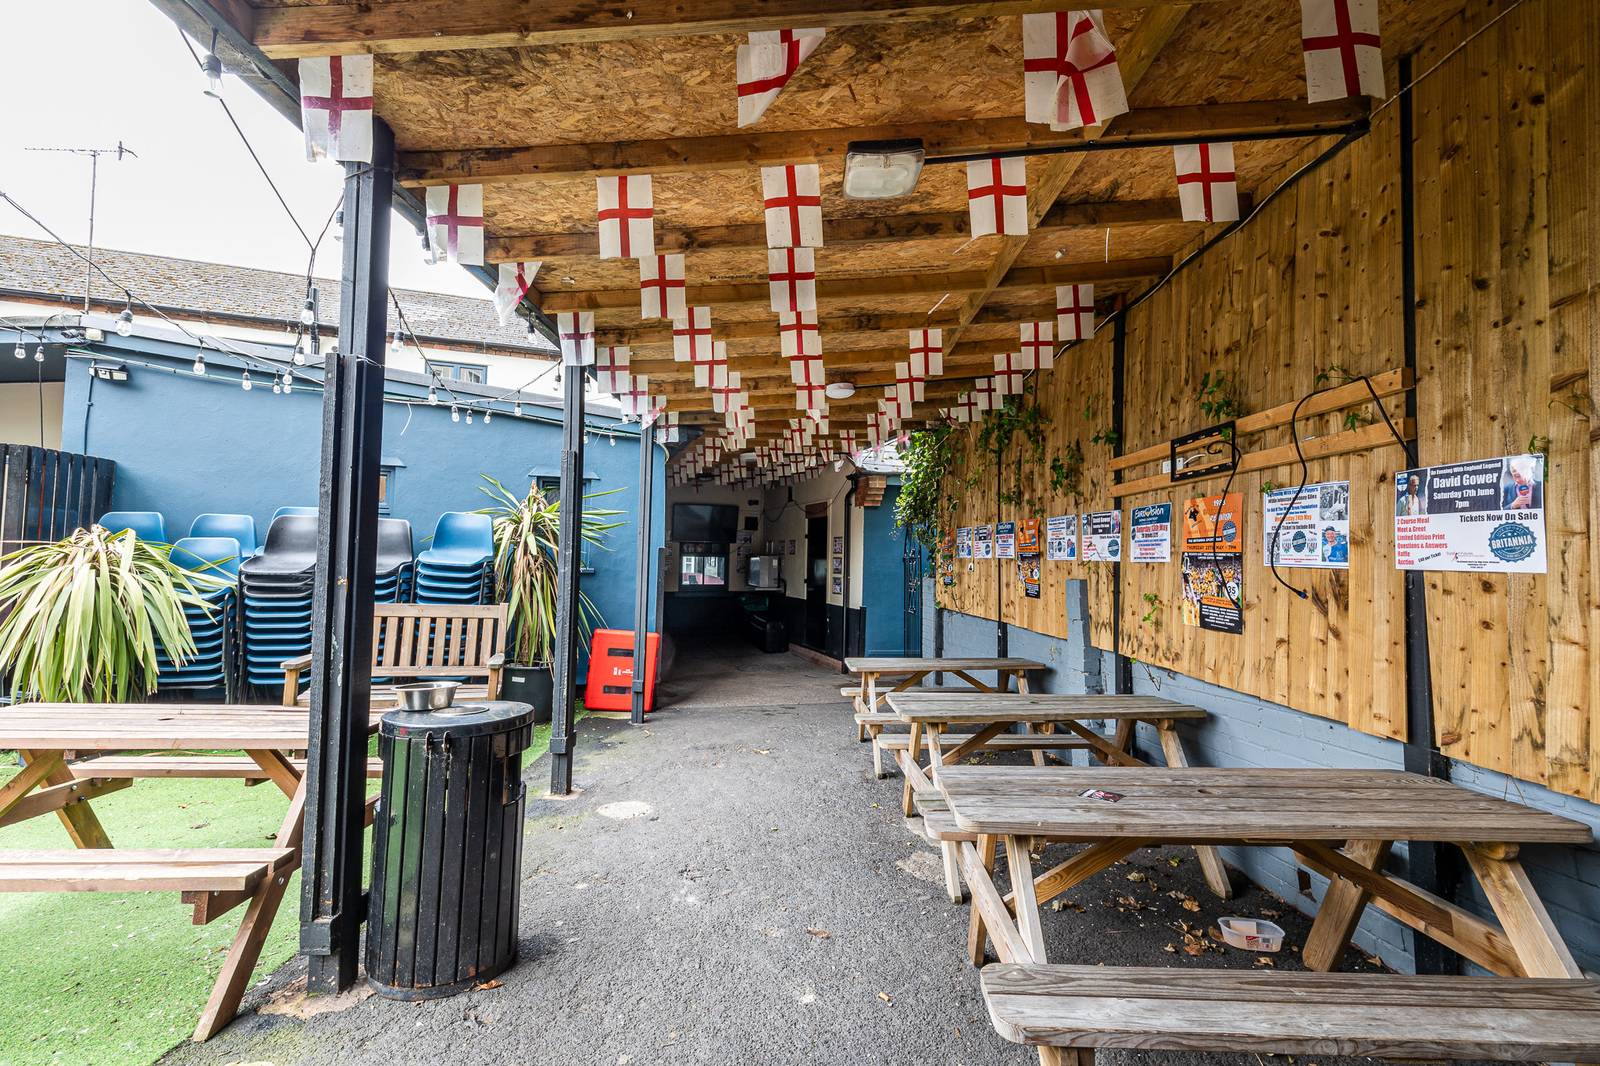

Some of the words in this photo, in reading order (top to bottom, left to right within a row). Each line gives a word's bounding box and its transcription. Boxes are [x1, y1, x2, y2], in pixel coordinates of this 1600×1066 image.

[1433, 475, 1460, 489] David
[1463, 472, 1498, 485] Gower
[1433, 490, 1462, 500] Saturday
[1463, 489, 1476, 497] 17th
[1505, 513, 1516, 521] On
[1518, 512, 1538, 520] Sale
[1492, 534, 1533, 549] BRITANNIA
